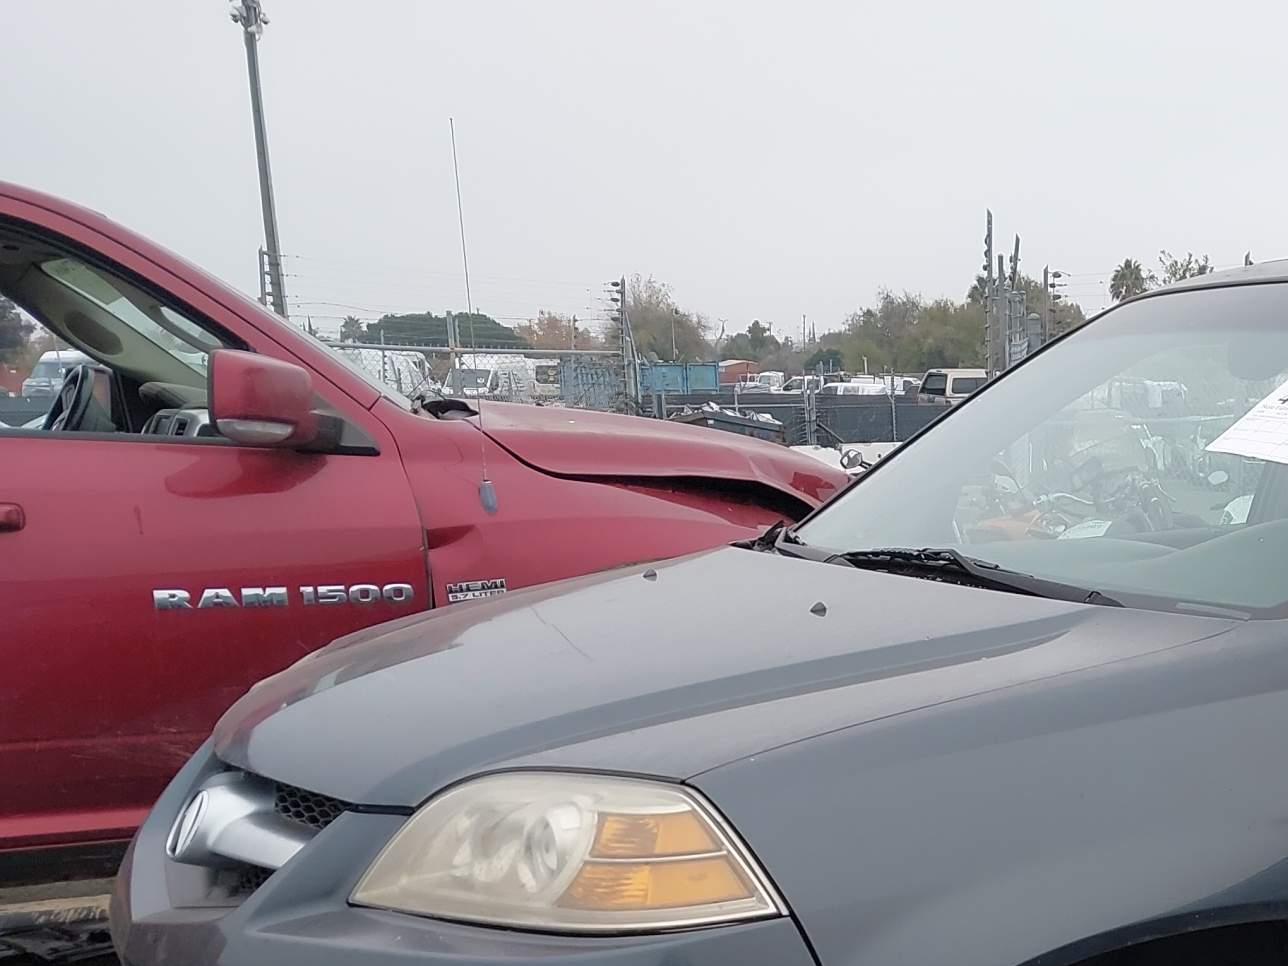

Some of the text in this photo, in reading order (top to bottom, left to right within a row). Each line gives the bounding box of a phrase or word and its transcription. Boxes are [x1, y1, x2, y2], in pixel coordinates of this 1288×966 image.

[153, 583, 415, 609] RAM 1500
[447, 579, 506, 593] HEMI
